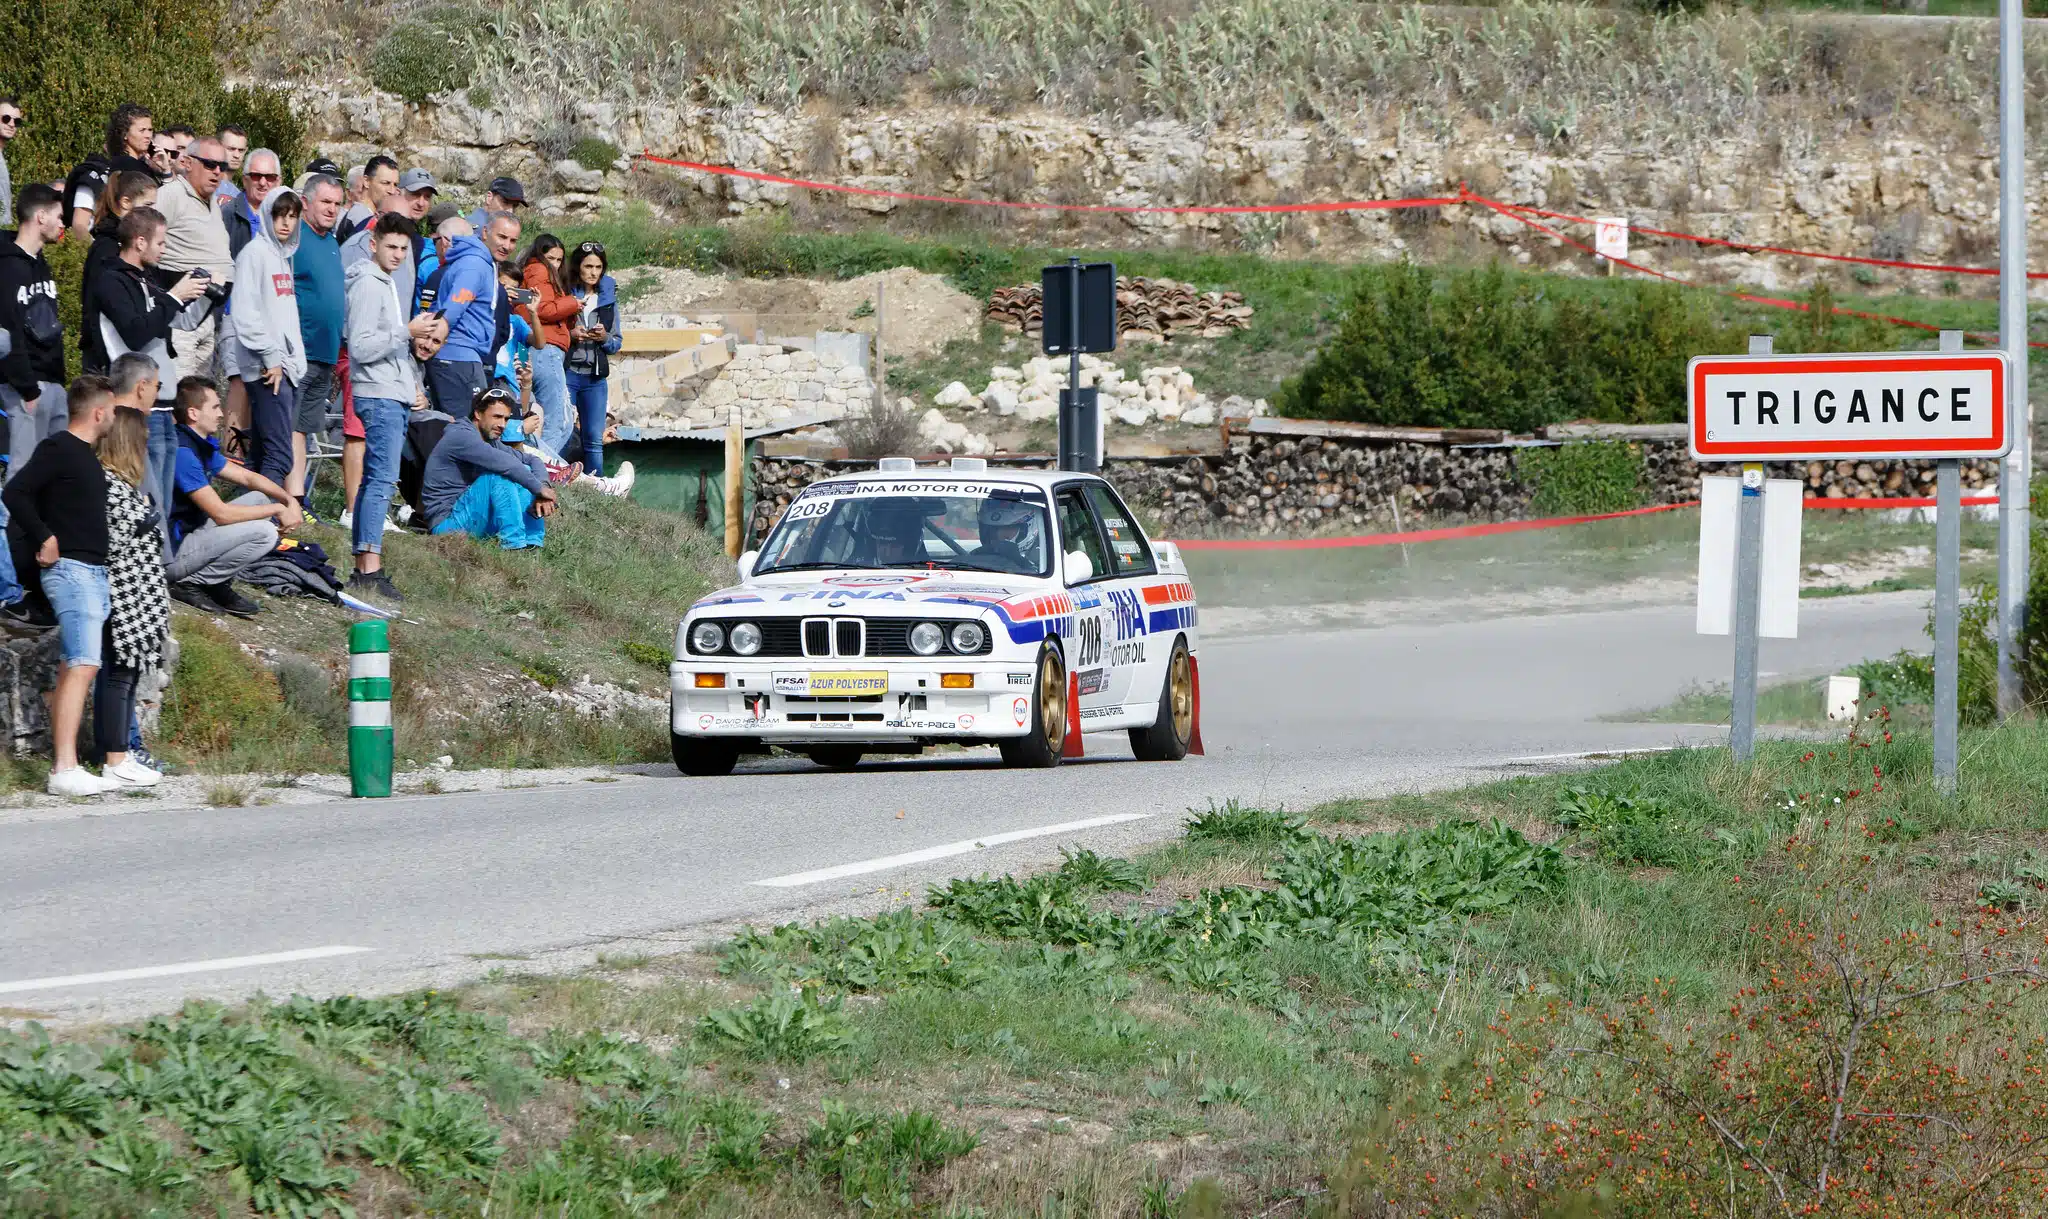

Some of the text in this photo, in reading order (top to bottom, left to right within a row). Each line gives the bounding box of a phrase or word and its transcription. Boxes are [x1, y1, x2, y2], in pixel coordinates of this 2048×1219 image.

[1726, 387, 1972, 425] TRIGANCE
[856, 485, 887, 493] INA
[891, 484, 959, 493] MOTOR
[963, 485, 991, 494] OIL
[789, 502, 830, 519] 208
[779, 589, 907, 602] FINA
[1107, 588, 1147, 641] INA
[1079, 615, 1102, 667] 208
[1111, 641, 1147, 667] OTOR OIL
[810, 678, 886, 689] AZUR POLYESTER
[1007, 673, 1033, 685] PIRELLI
